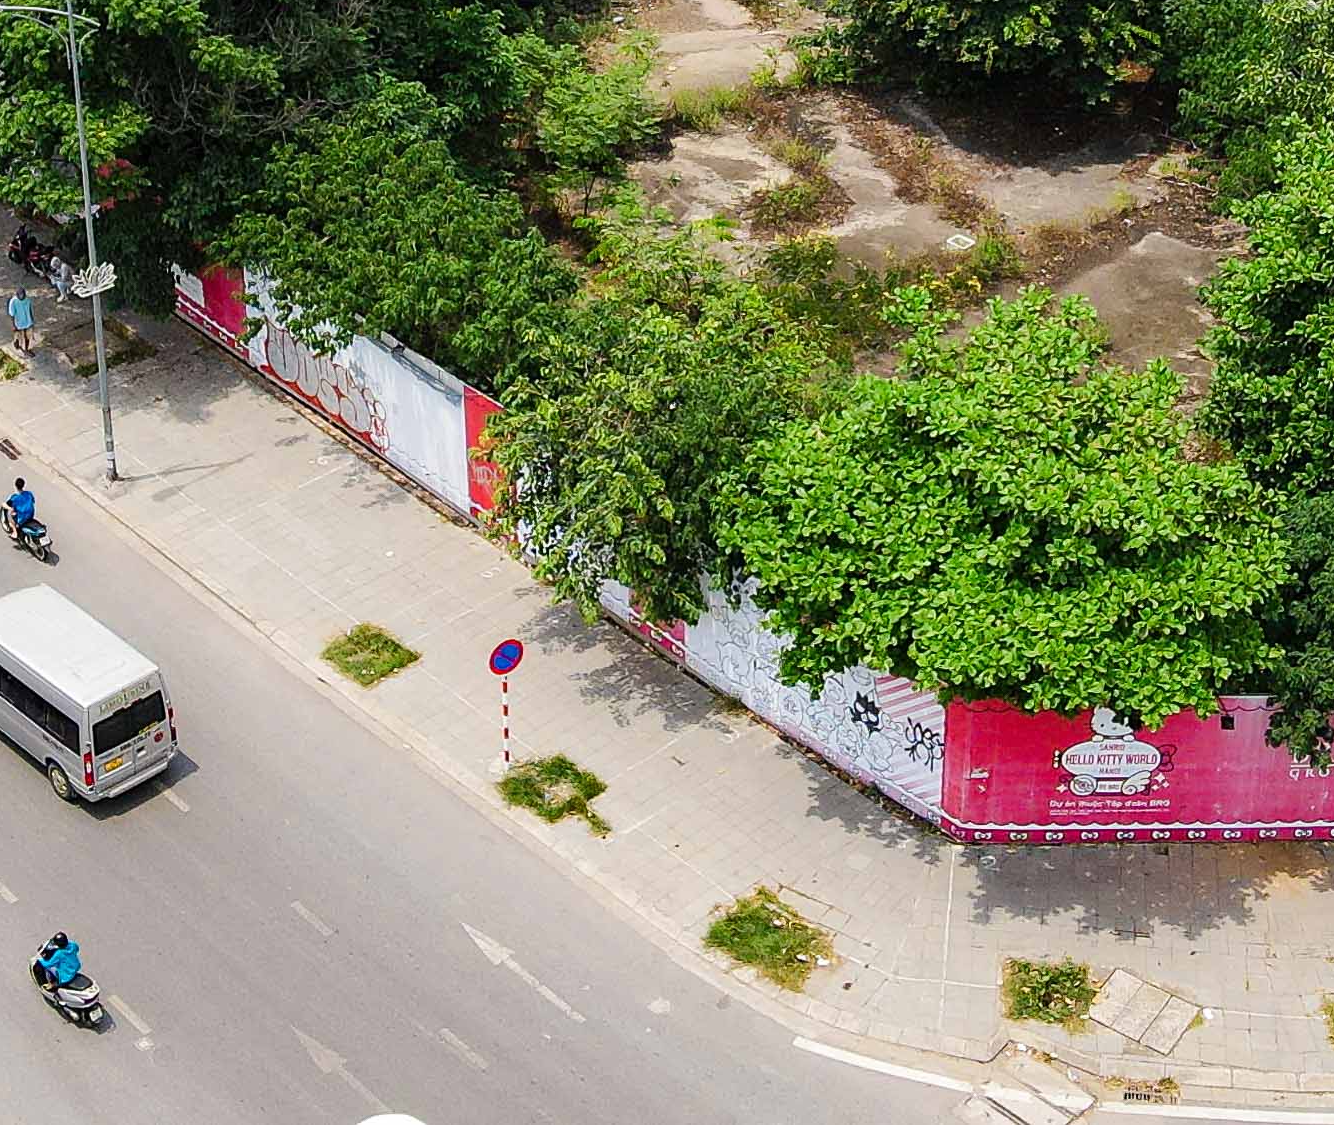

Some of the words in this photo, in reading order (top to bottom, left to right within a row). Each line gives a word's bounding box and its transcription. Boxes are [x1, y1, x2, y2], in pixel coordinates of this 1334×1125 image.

[1065, 754, 1095, 765] HELLO
[1097, 754, 1124, 765] KITTY
[1125, 754, 1158, 765] WORLD
